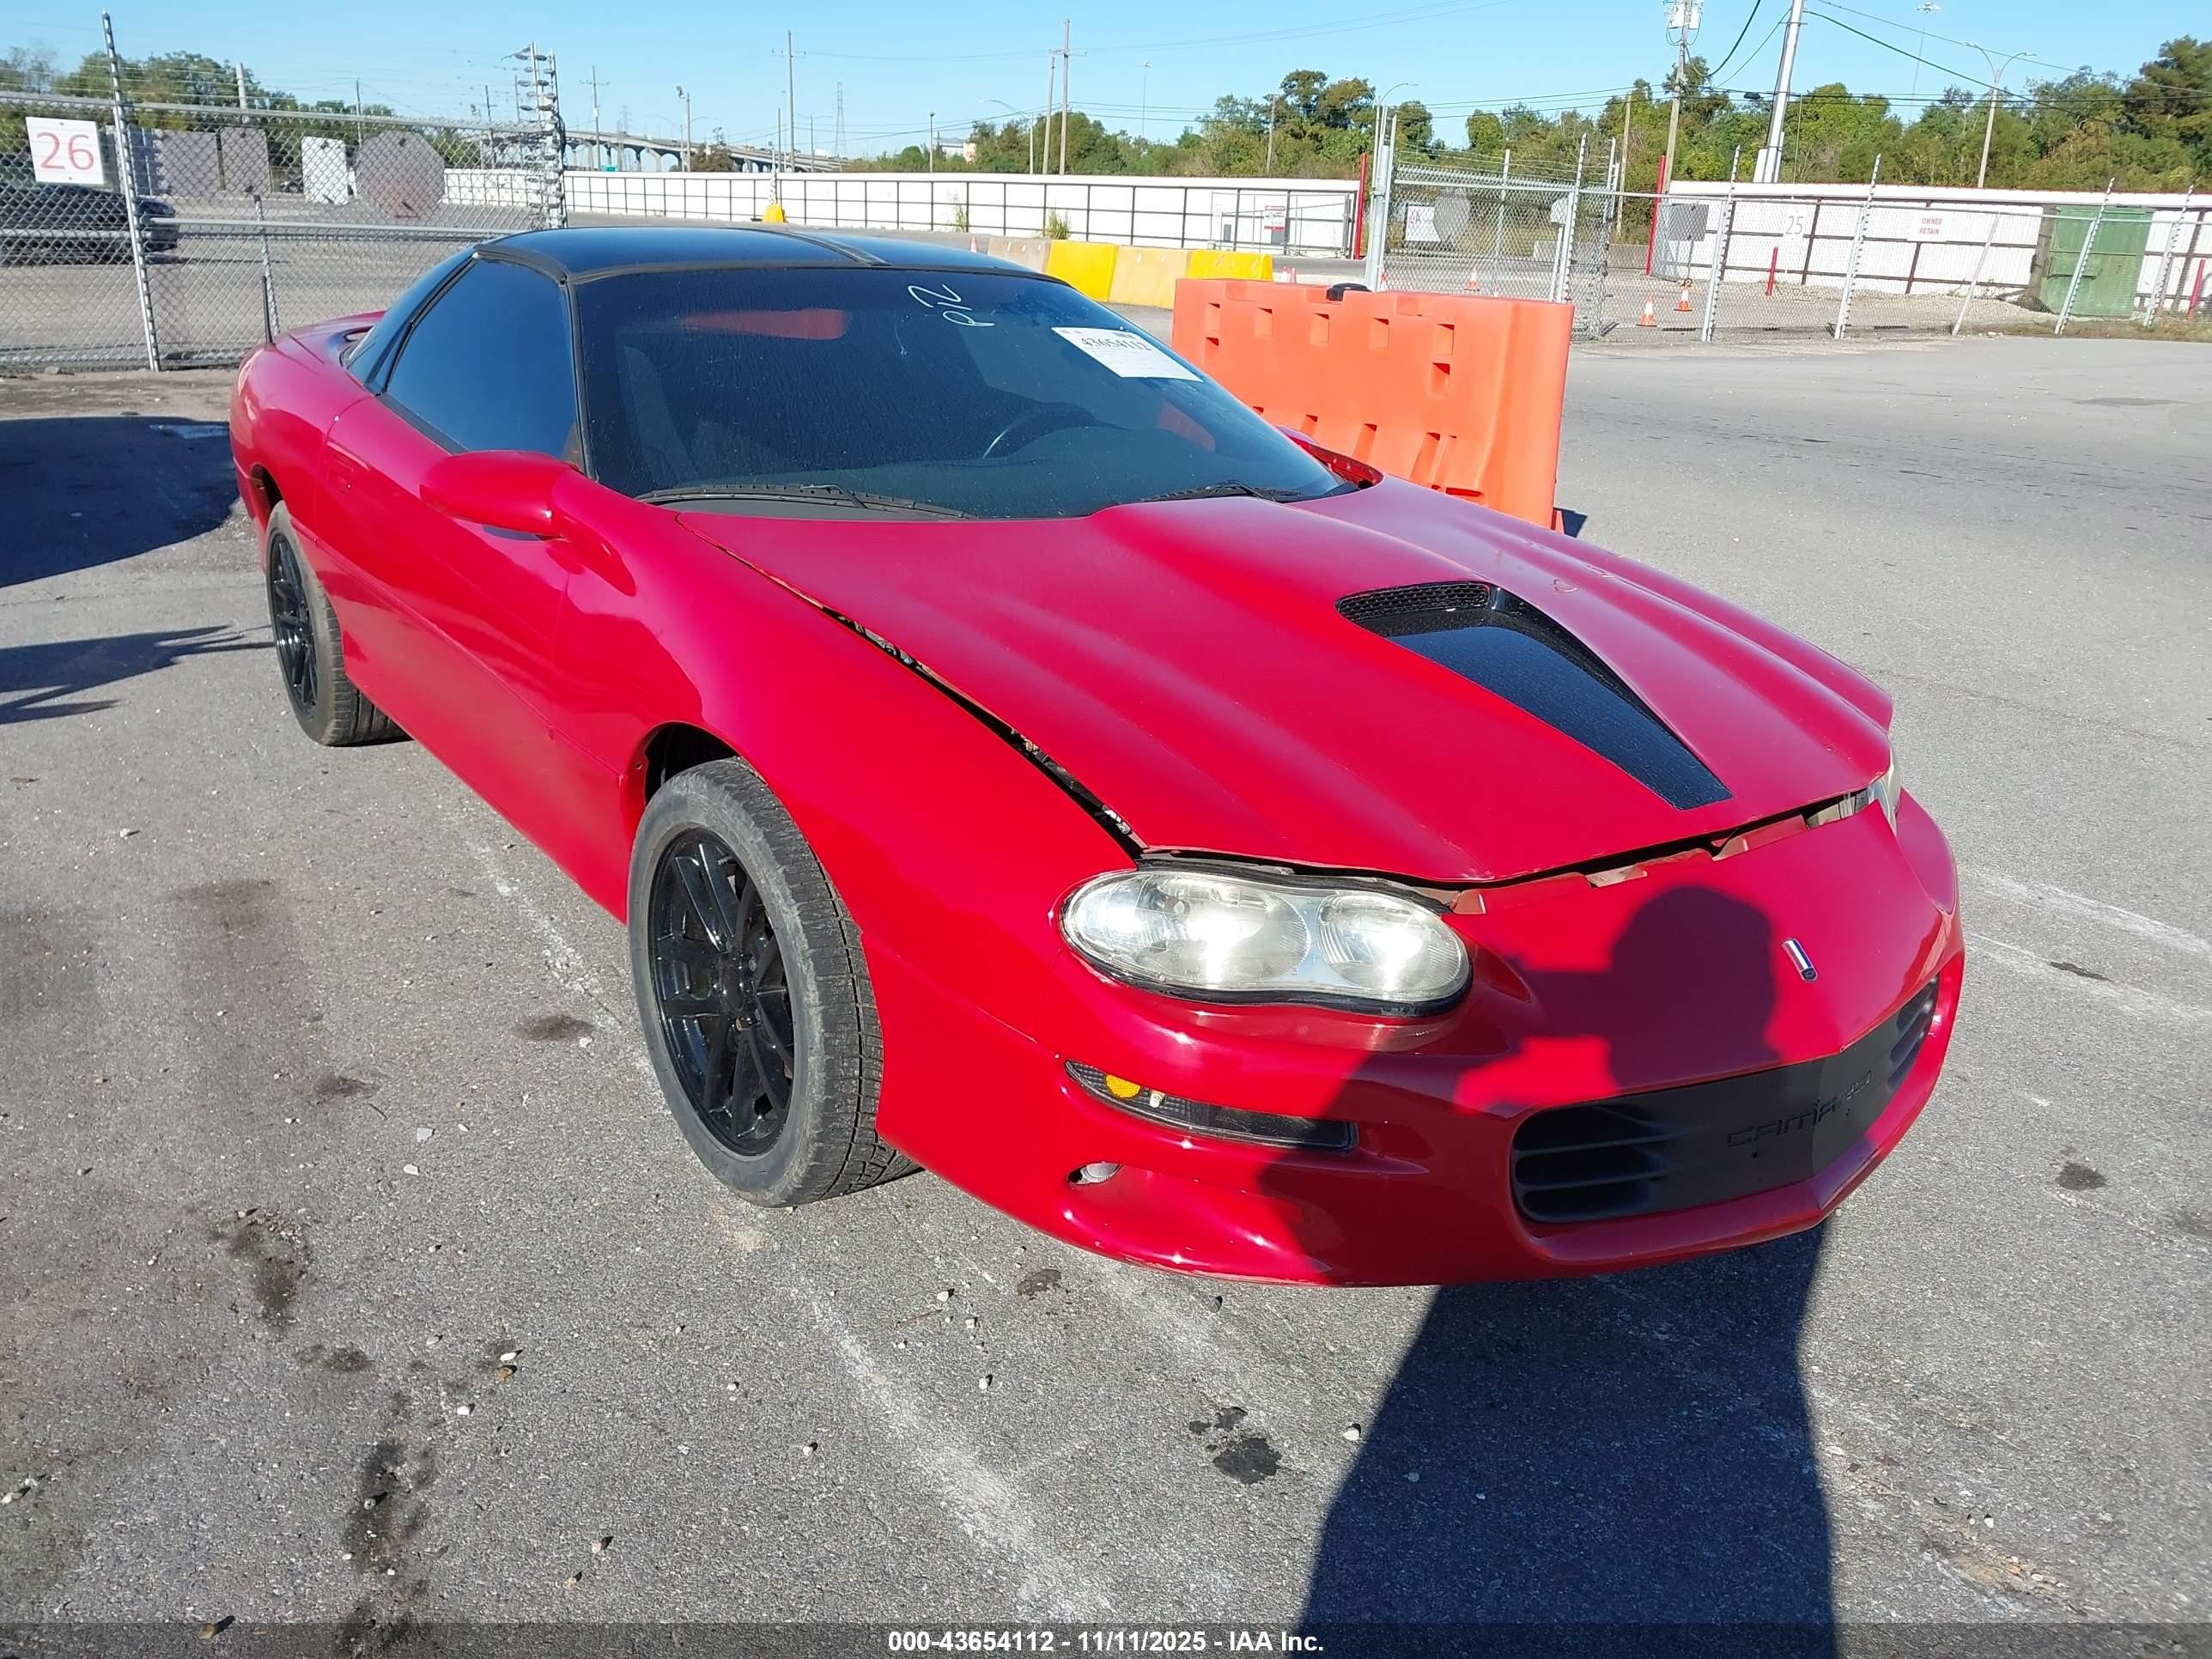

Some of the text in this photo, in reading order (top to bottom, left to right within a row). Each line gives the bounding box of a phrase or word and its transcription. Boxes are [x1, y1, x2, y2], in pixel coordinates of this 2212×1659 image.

[37, 131, 94, 170] 26
[1786, 216, 1803, 234] 25
[1081, 337, 1152, 351] 43654112
